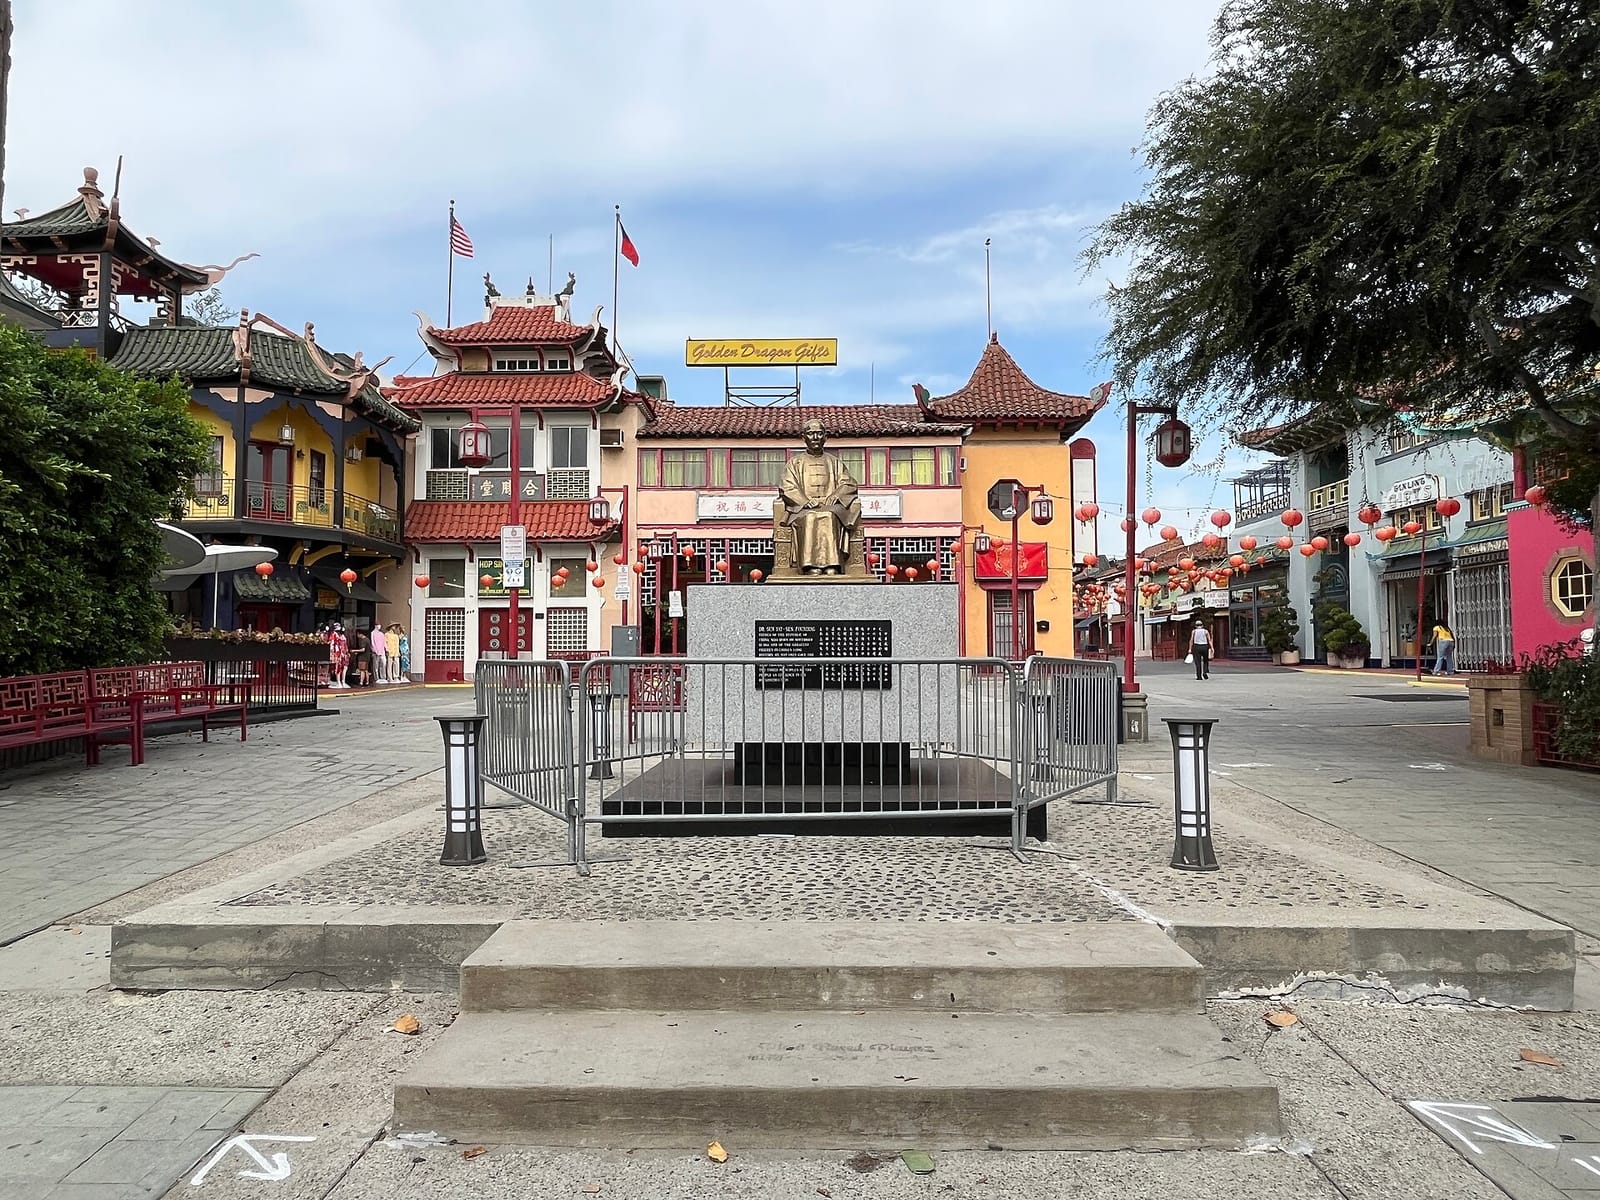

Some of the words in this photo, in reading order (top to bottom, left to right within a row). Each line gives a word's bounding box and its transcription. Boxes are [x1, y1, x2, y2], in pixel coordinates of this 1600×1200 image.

[692, 343, 738, 363] Golden
[740, 343, 791, 362] Dragon
[794, 343, 829, 362] Gifts
[479, 560, 493, 569] HOP
